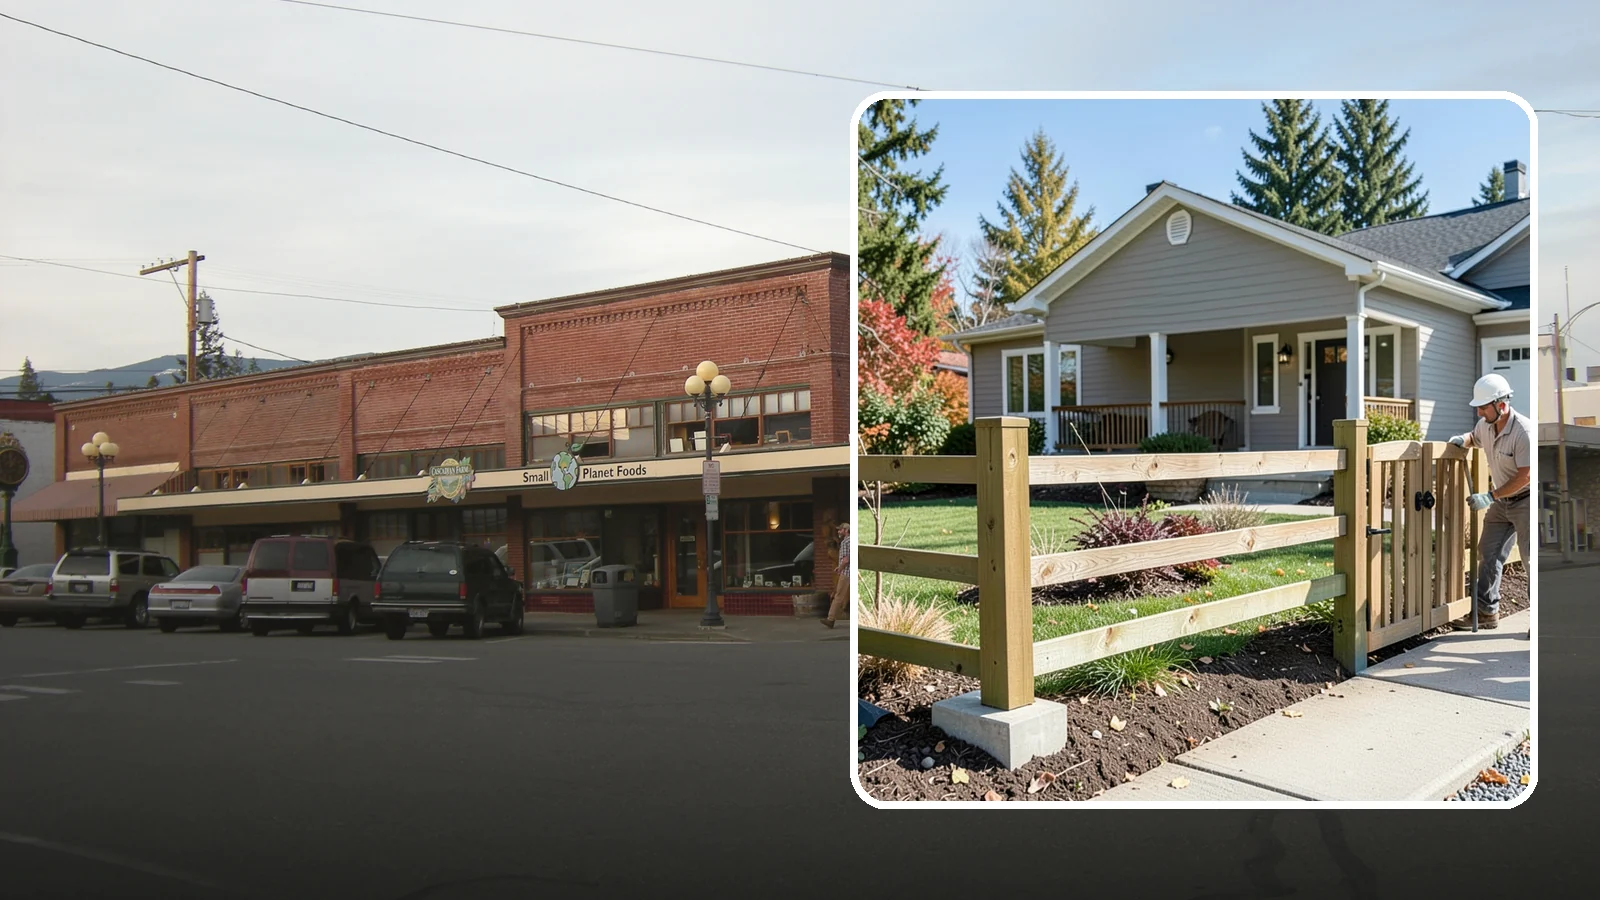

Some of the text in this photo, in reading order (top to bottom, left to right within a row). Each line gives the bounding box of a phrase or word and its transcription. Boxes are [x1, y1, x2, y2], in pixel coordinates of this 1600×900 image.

[523, 464, 647, 483] Small Planet Foods
